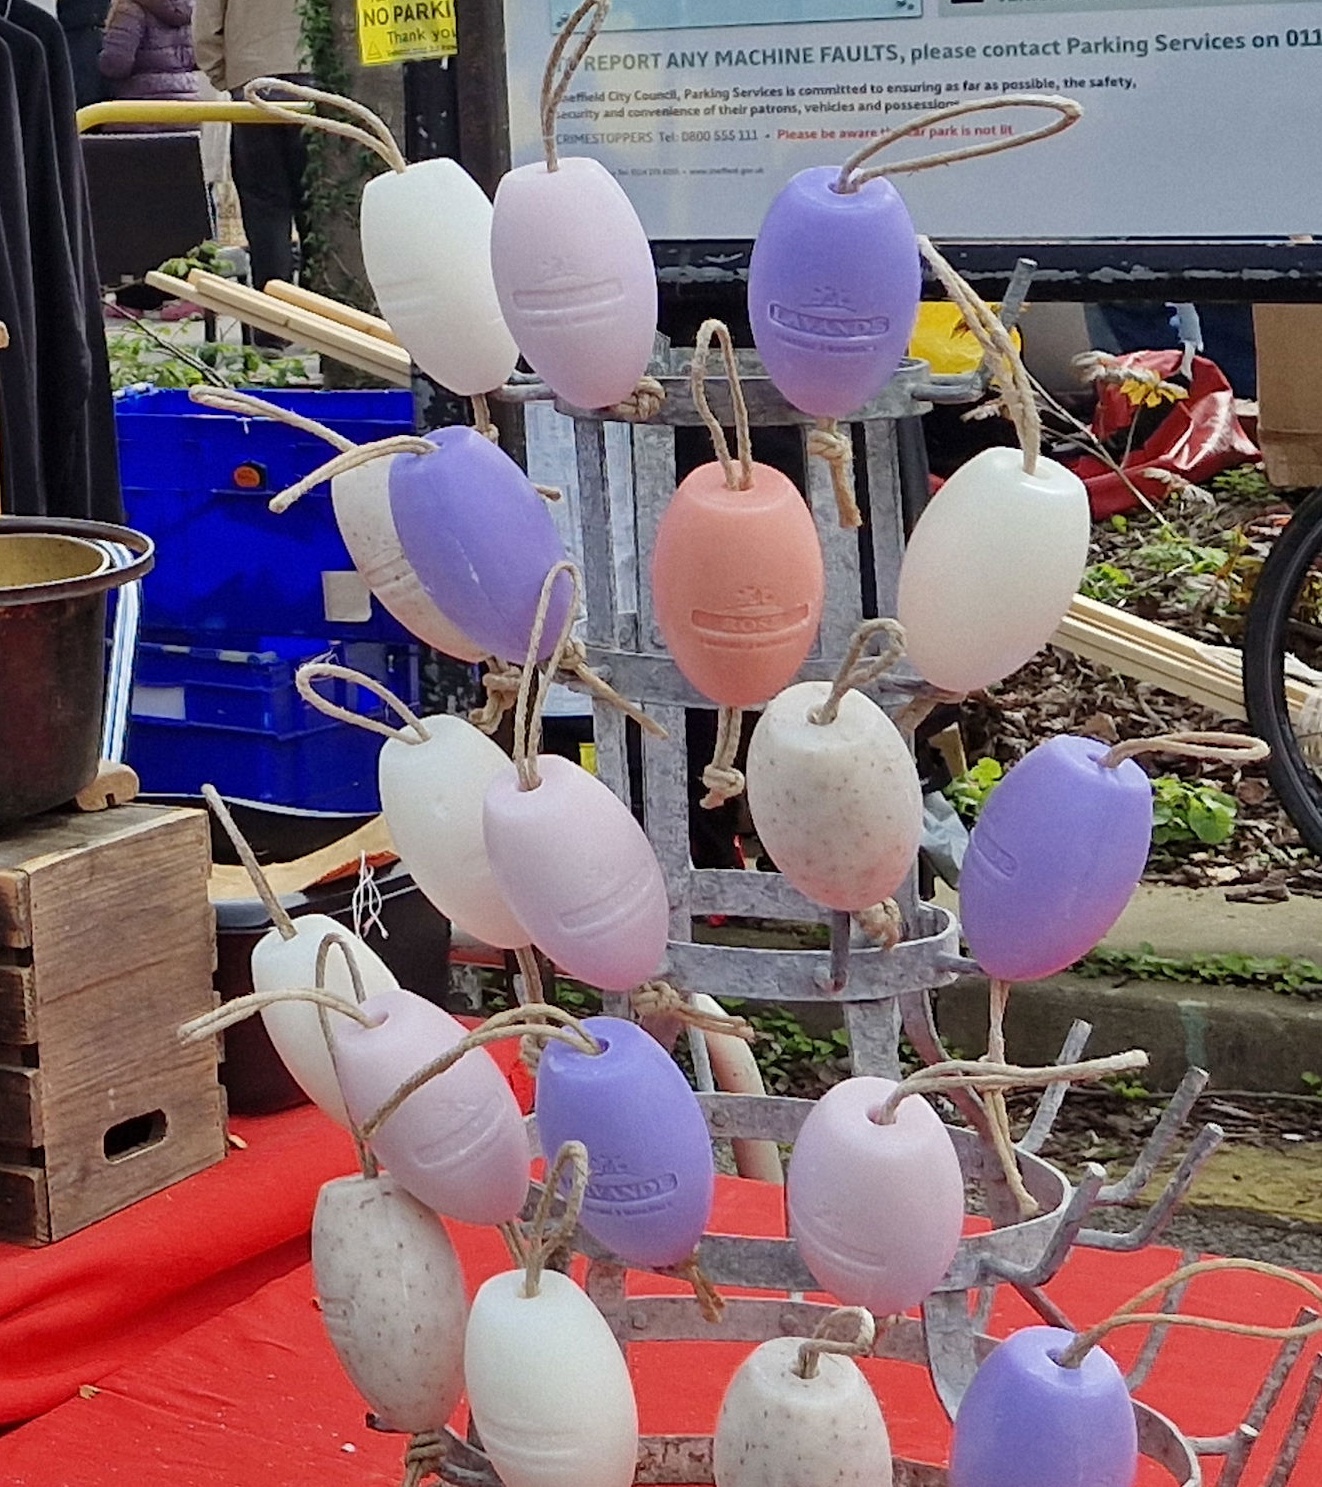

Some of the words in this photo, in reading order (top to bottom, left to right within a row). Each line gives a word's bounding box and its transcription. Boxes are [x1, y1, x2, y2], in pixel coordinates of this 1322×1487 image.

[363, 7, 389, 27] NO
[387, 27, 426, 45] Thank
[584, 52, 662, 71] REPORT
[666, 51, 707, 70] ANY
[714, 47, 813, 68] MACHINE
[820, 44, 906, 65] FAULTS,
[910, 41, 976, 65] please
[982, 37, 1061, 58] contact
[1067, 36, 1148, 58] Parking
[1155, 32, 1245, 53] Services
[1252, 32, 1280, 49] on
[945, 82, 959, 92] as
[963, 80, 980, 91] far
[984, 81, 999, 91] as
[1002, 78, 1060, 93] possible,
[1064, 77, 1085, 89] the
[1089, 76, 1137, 90] safety,
